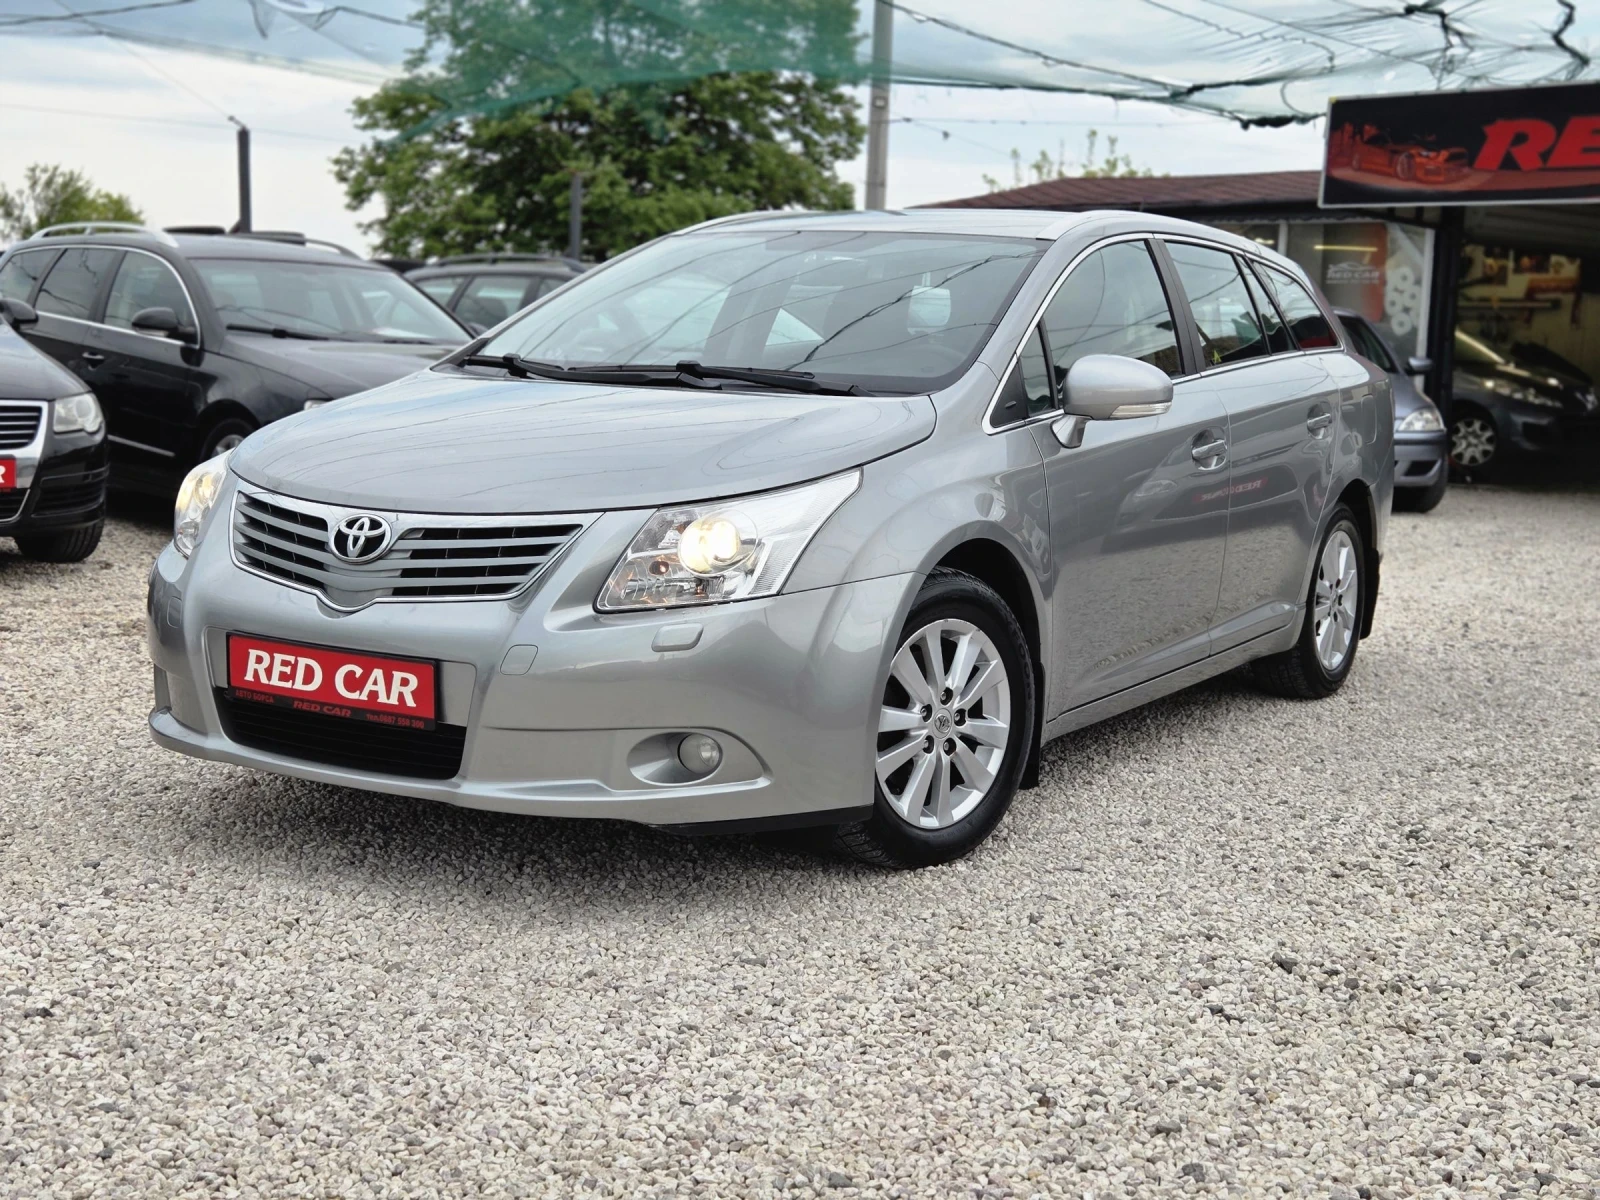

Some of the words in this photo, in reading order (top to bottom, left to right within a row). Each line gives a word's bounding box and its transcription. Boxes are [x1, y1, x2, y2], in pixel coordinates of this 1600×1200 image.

[244, 649, 323, 692] RED
[334, 664, 418, 708] CAR
[293, 700, 320, 713] RED
[323, 705, 351, 718] CAR
